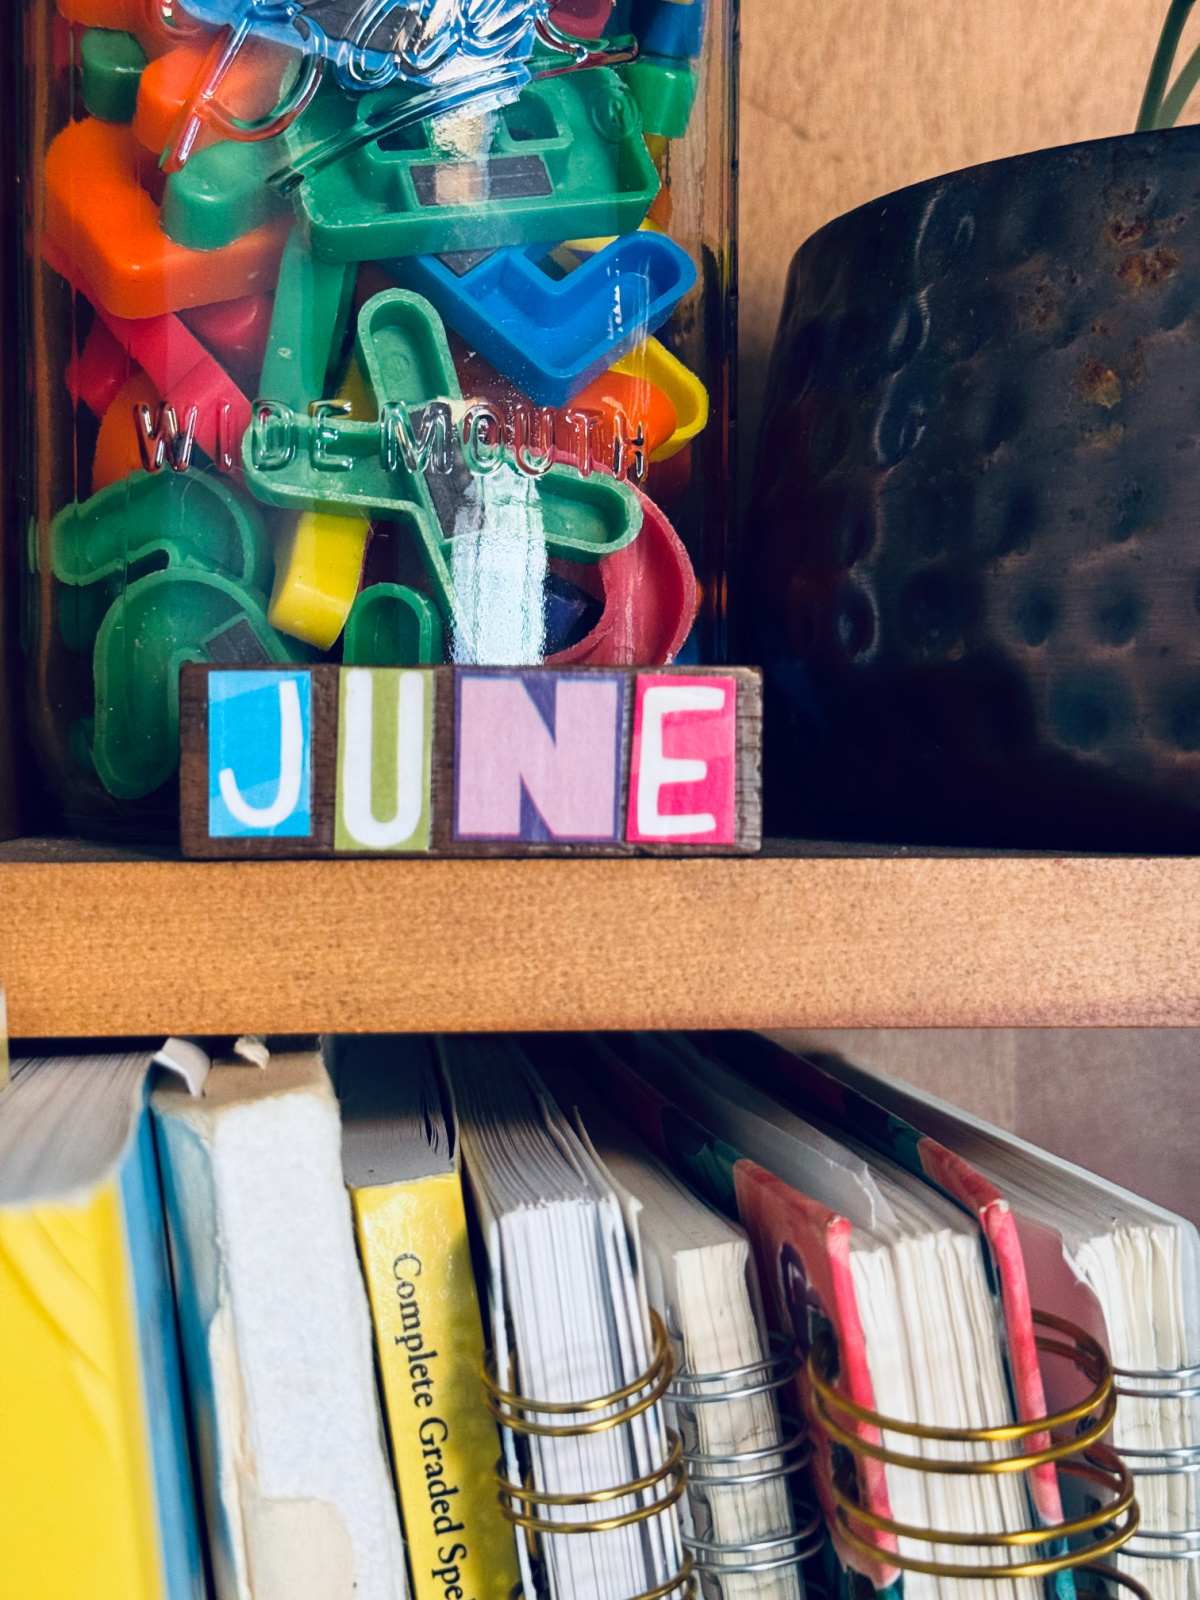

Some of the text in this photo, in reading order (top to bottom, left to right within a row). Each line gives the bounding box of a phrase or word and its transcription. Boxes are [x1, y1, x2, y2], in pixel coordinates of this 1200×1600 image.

[133, 400, 650, 481] WIDE MOUTH
[219, 668, 726, 847] JUNE
[393, 1253, 476, 1600] Complete Graded Spe
